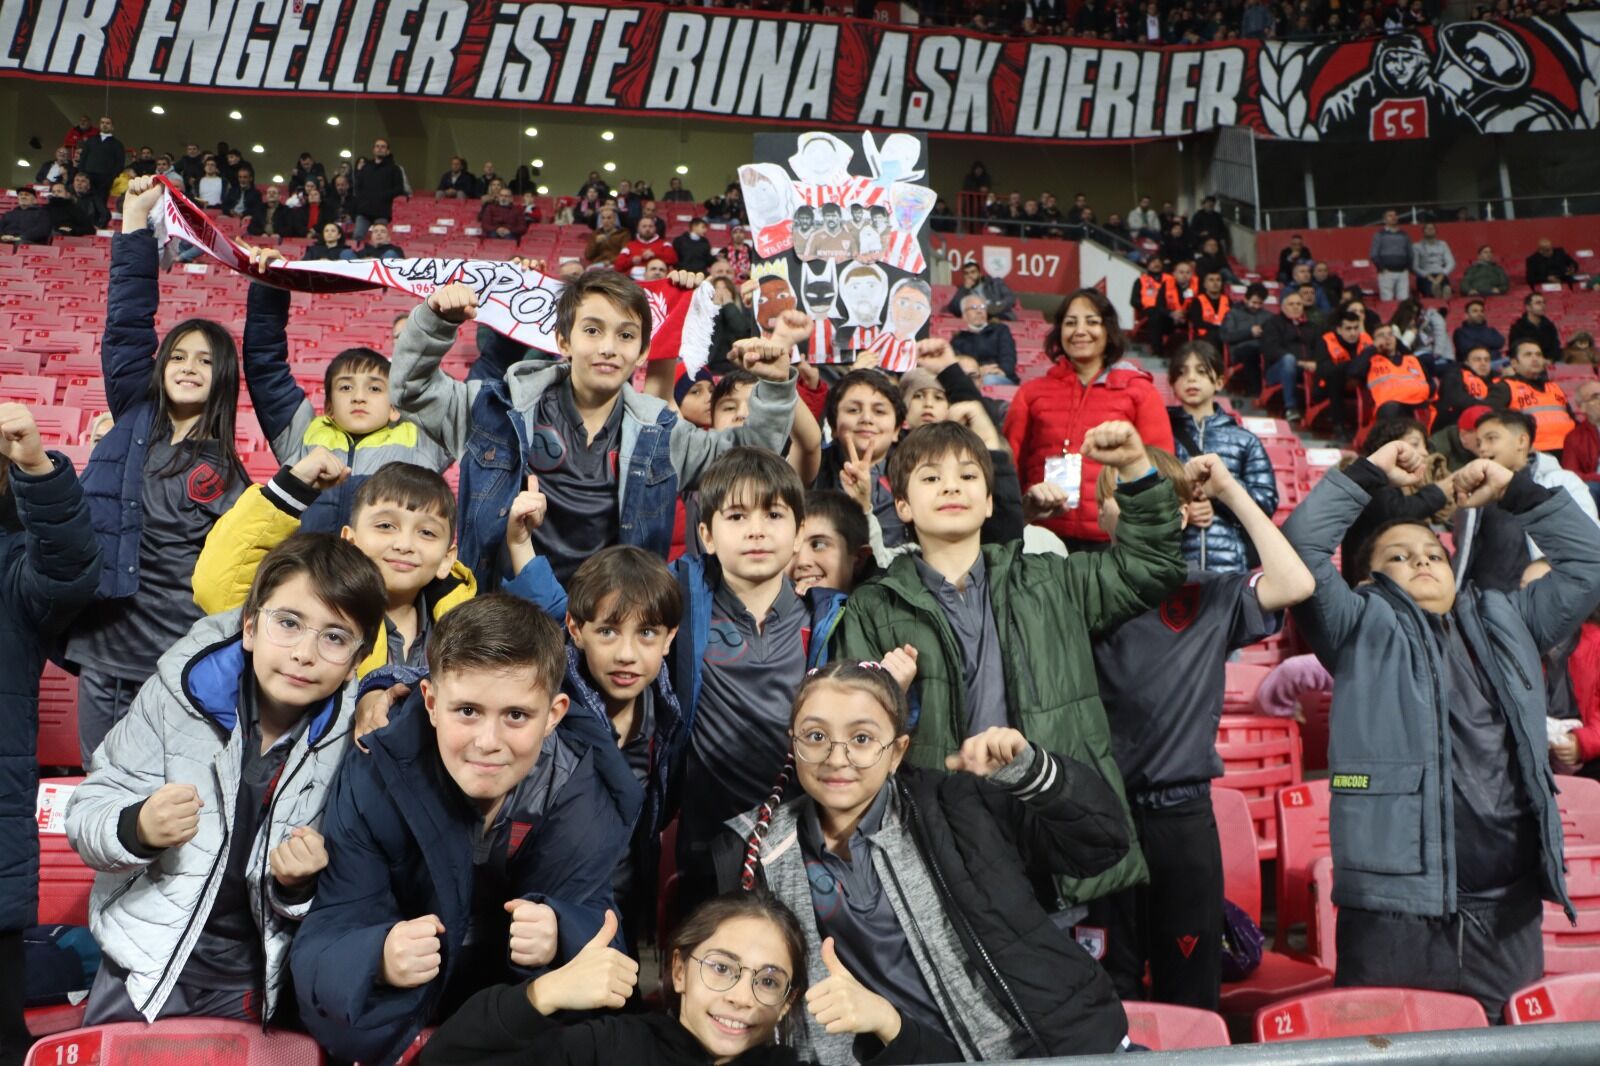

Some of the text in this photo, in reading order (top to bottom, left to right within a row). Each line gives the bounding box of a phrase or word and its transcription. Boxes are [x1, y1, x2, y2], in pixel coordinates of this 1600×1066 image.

[128, 0, 470, 96] ENGELLER
[646, 12, 840, 120] BUNA
[1015, 43, 1245, 138] DERLER
[1384, 108, 1415, 136] 55
[944, 248, 977, 272] 06
[1016, 253, 1060, 277] 107
[411, 283, 436, 294] 1965
[1524, 997, 1543, 1016] 23
[1274, 1011, 1294, 1035] 22
[56, 1043, 79, 1065] 18
